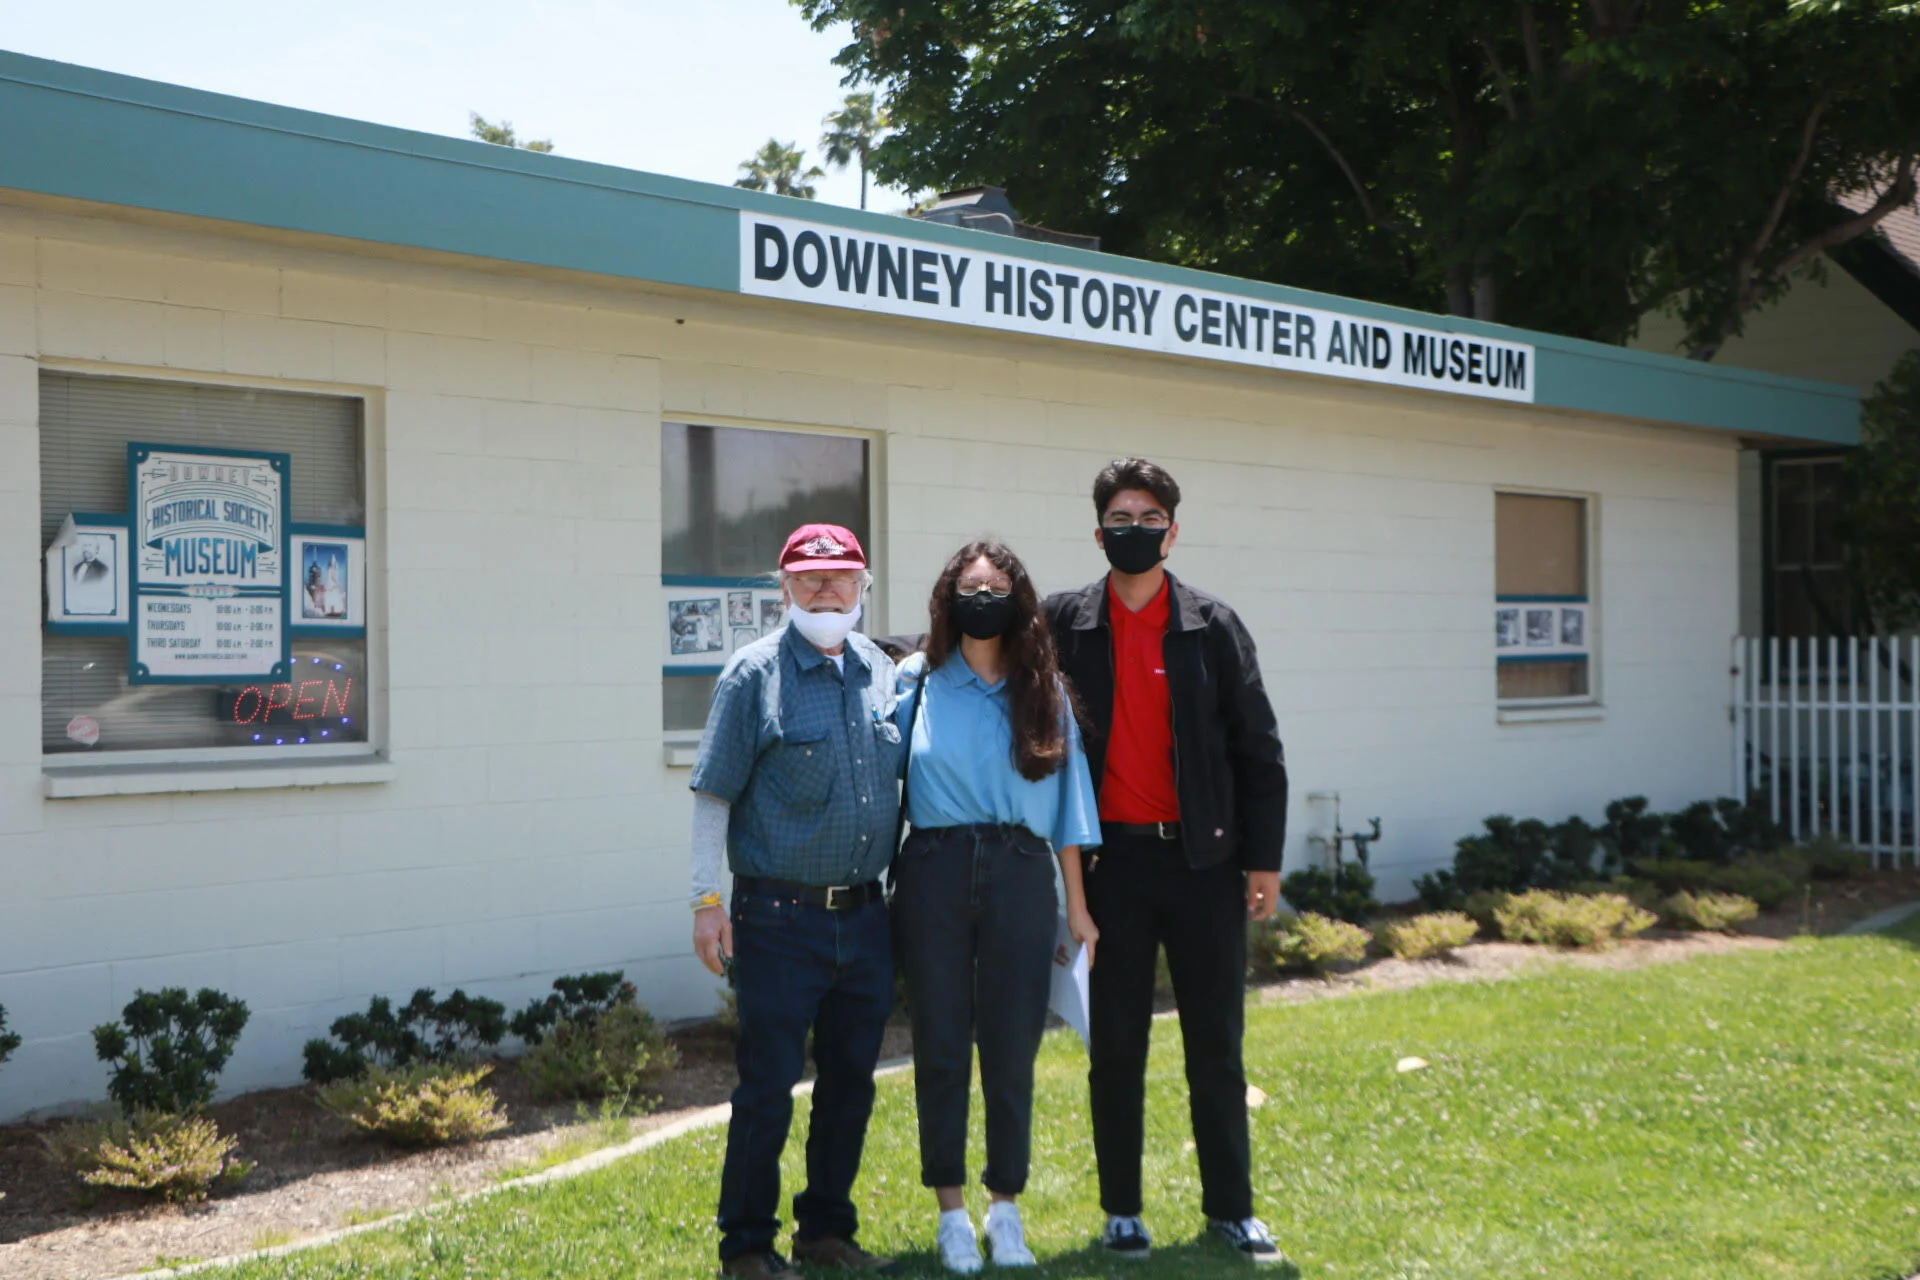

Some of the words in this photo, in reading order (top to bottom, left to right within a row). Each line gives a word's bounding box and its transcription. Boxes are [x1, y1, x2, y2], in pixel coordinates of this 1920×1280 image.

[754, 222, 971, 308] DOWNEY
[985, 261, 1162, 336] HISTORY
[1174, 293, 1317, 360] CENTER
[1327, 320, 1392, 370] AND
[1403, 332, 1526, 391] MUSEUM
[169, 463, 251, 486] DOWNEY
[152, 499, 219, 530] HISTORICAL
[223, 501, 269, 533] SOCIETY
[165, 537, 256, 579] MUSEUM
[147, 602, 192, 614] WEDNESDAYS
[147, 619, 186, 631] THURSDAYS
[146, 637, 167, 648] THIRD
[233, 677, 352, 725] OPEN
